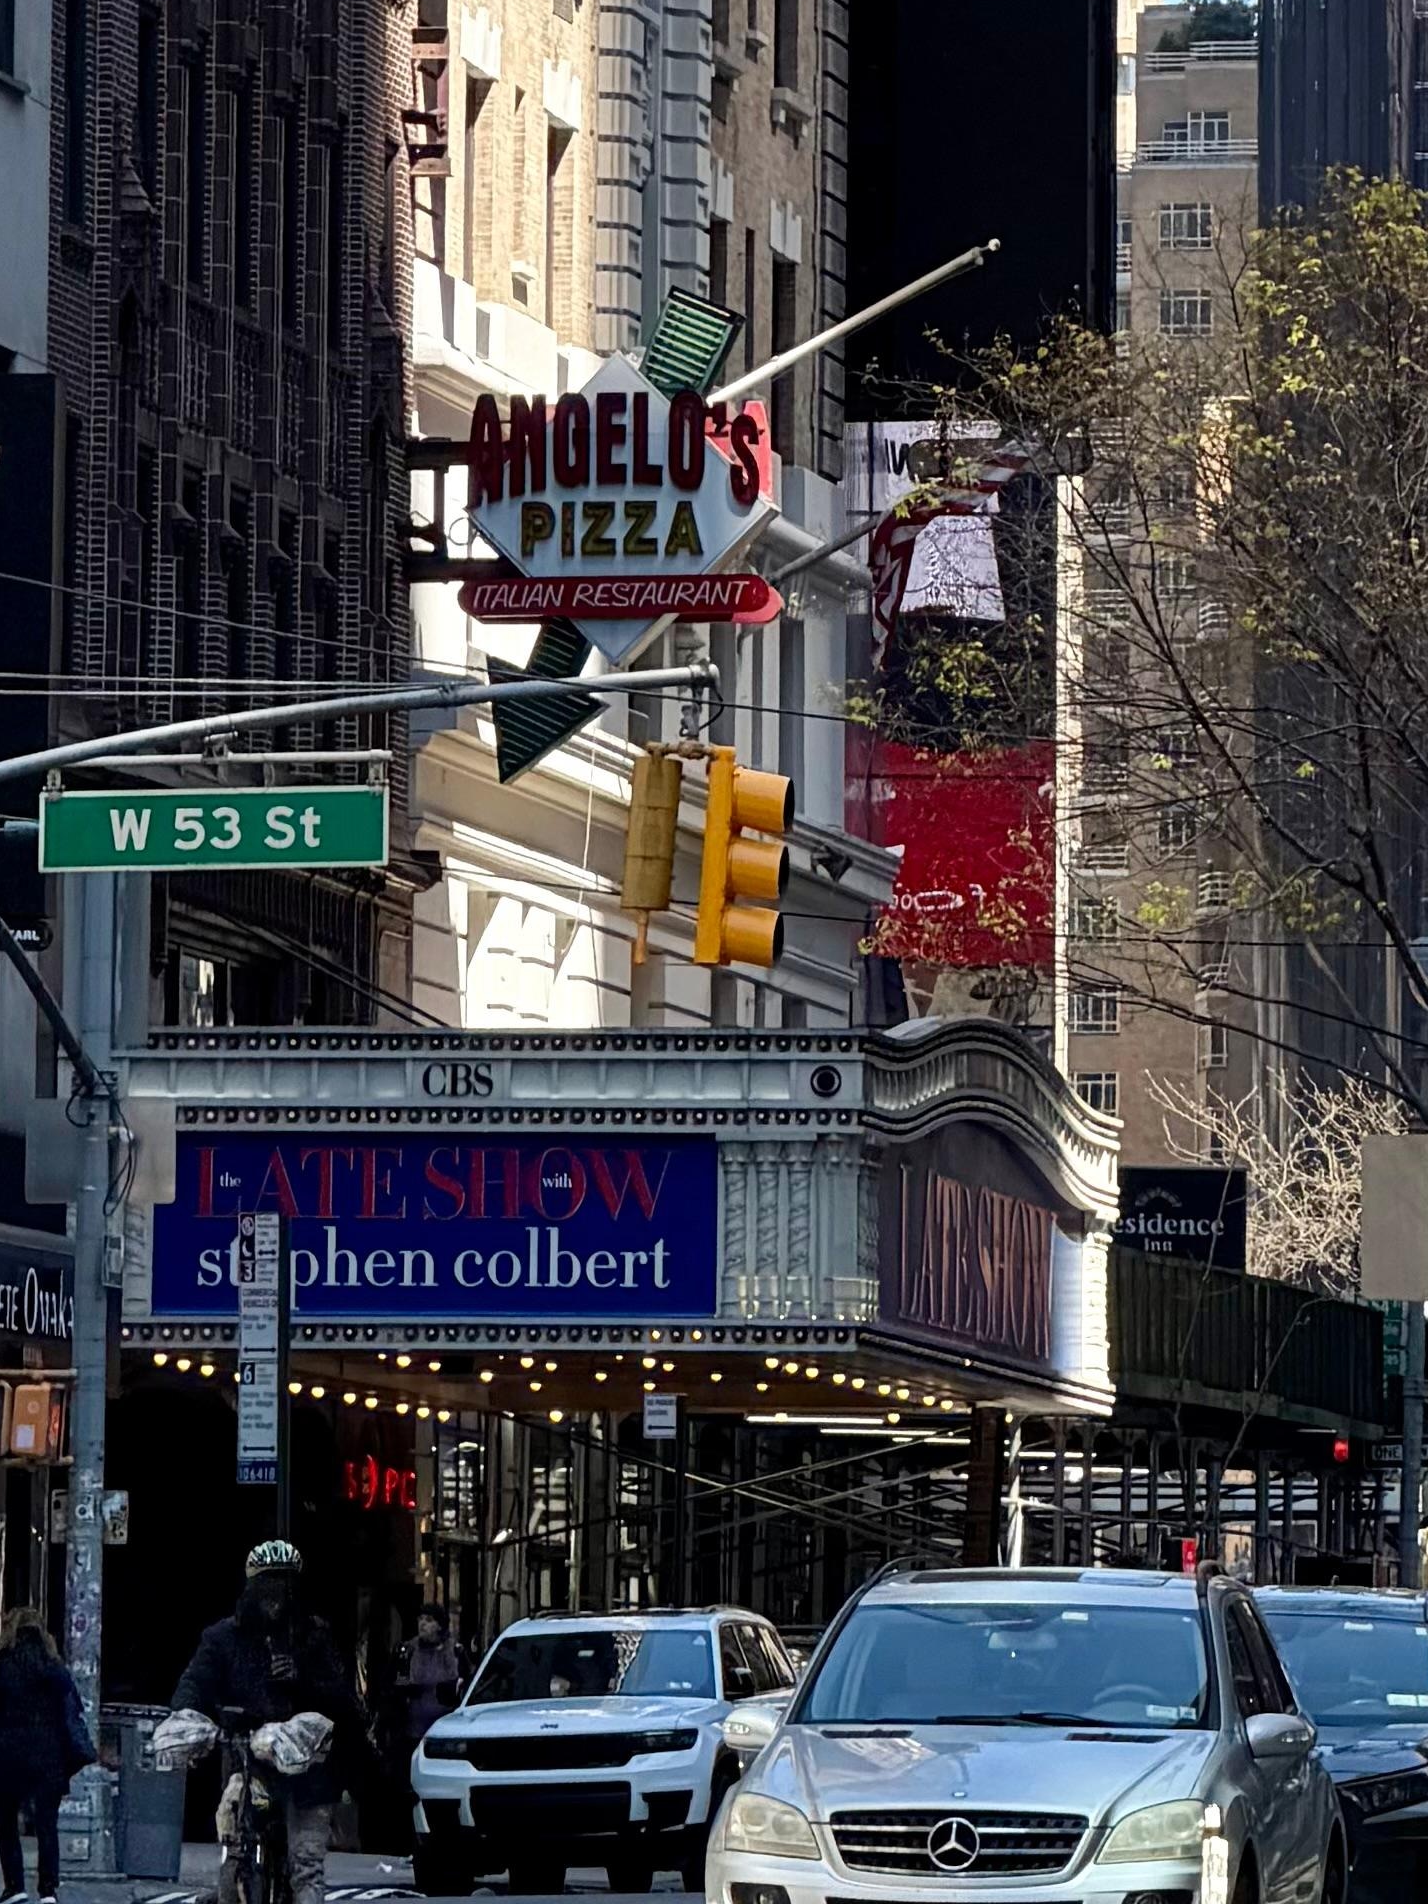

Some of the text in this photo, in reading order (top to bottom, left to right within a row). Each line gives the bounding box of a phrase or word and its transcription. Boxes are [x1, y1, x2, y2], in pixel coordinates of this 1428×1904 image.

[471, 389, 762, 508] ANGELO'S
[521, 501, 703, 559] PIZZA
[473, 581, 750, 608] ITALIAN RESTAURANT
[109, 804, 322, 852] W 53 St
[422, 1062, 494, 1098] CBS
[194, 1146, 672, 1220] LATE SHOW
[219, 1171, 241, 1188] the
[542, 1171, 573, 1189] with
[1116, 1213, 1225, 1236] esidence
[196, 1226, 439, 1311] stphen
[453, 1227, 671, 1288] colbert
[899, 1162, 1058, 1360] LATE SHOW
[243, 1365, 252, 1383] 6
[1375, 1448, 1400, 1460] ONE
